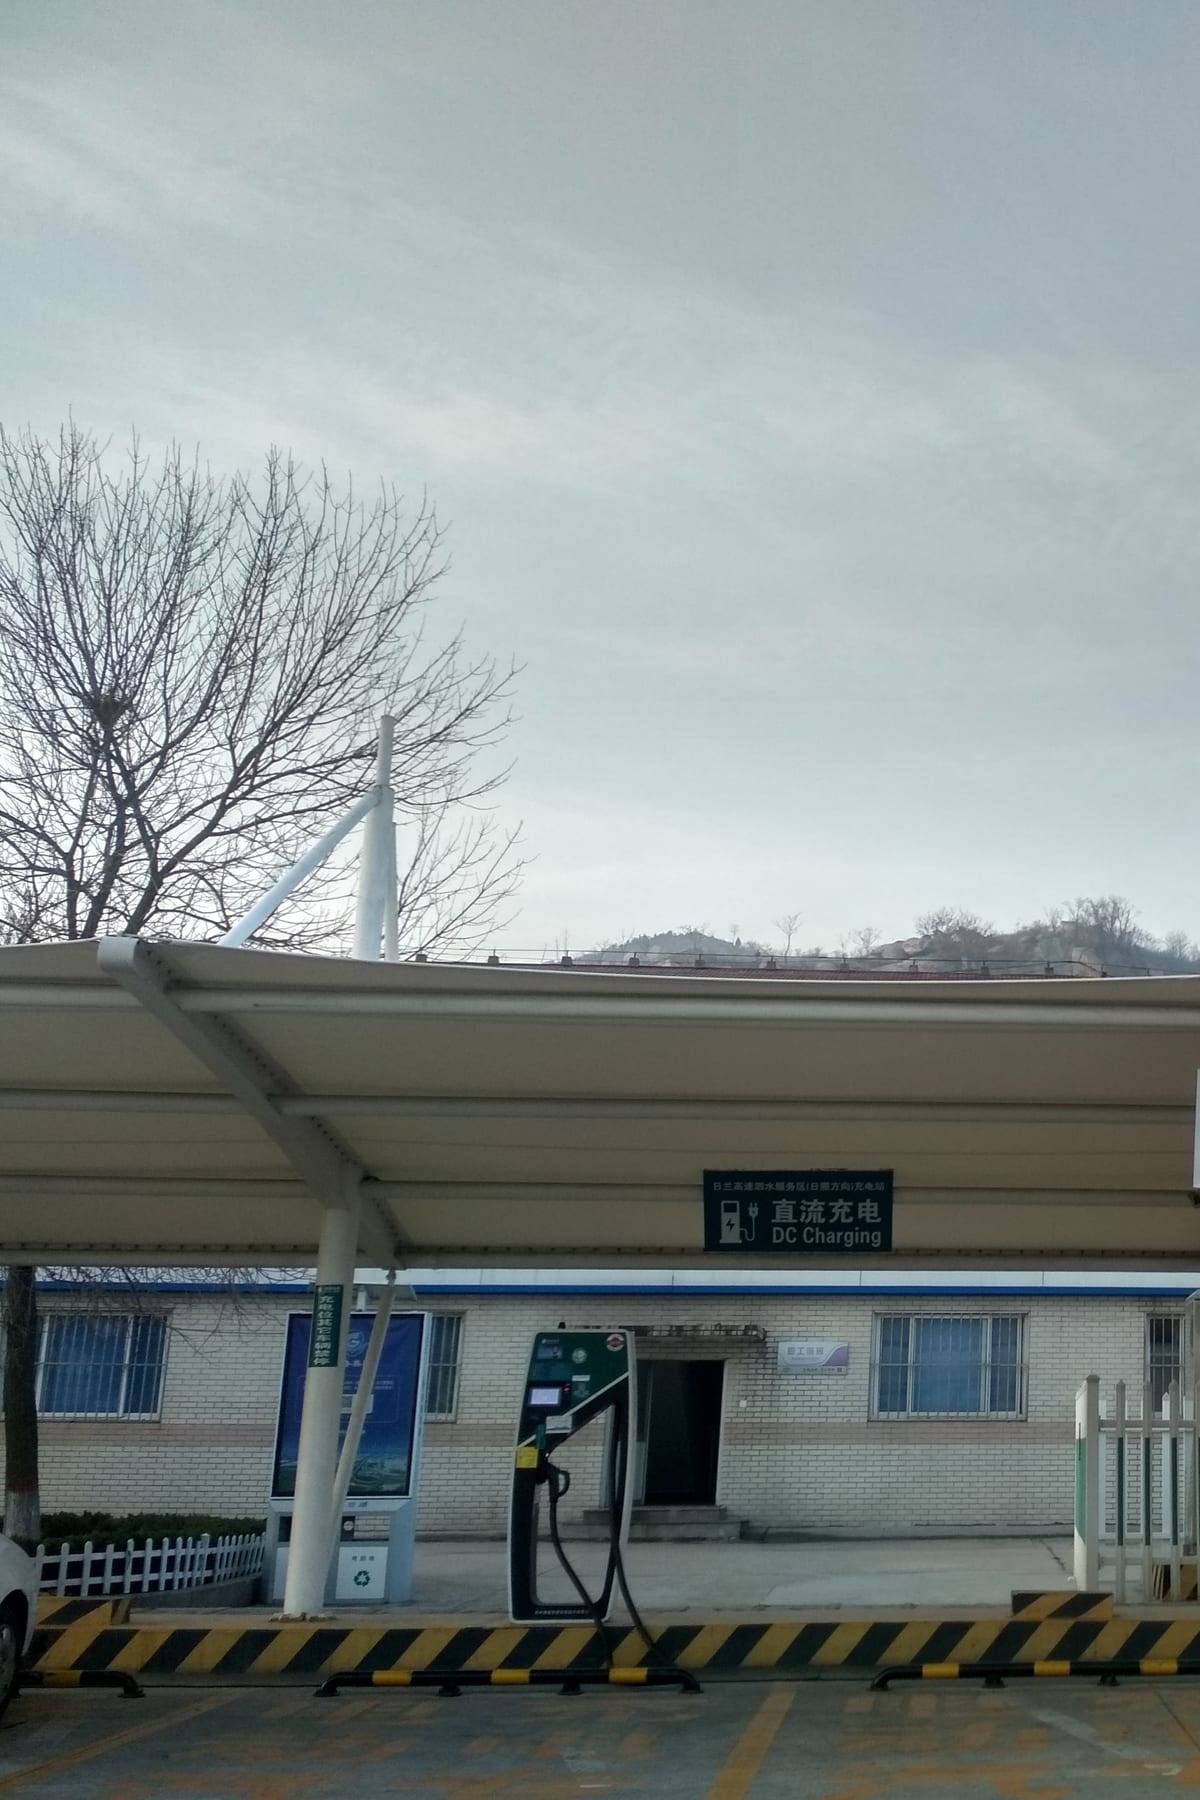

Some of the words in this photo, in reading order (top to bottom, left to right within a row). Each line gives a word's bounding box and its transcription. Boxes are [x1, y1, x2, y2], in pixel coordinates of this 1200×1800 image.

[771, 1198, 882, 1224] 直流充电
[772, 1226, 797, 1244] DC
[802, 1226, 882, 1248] Charging
